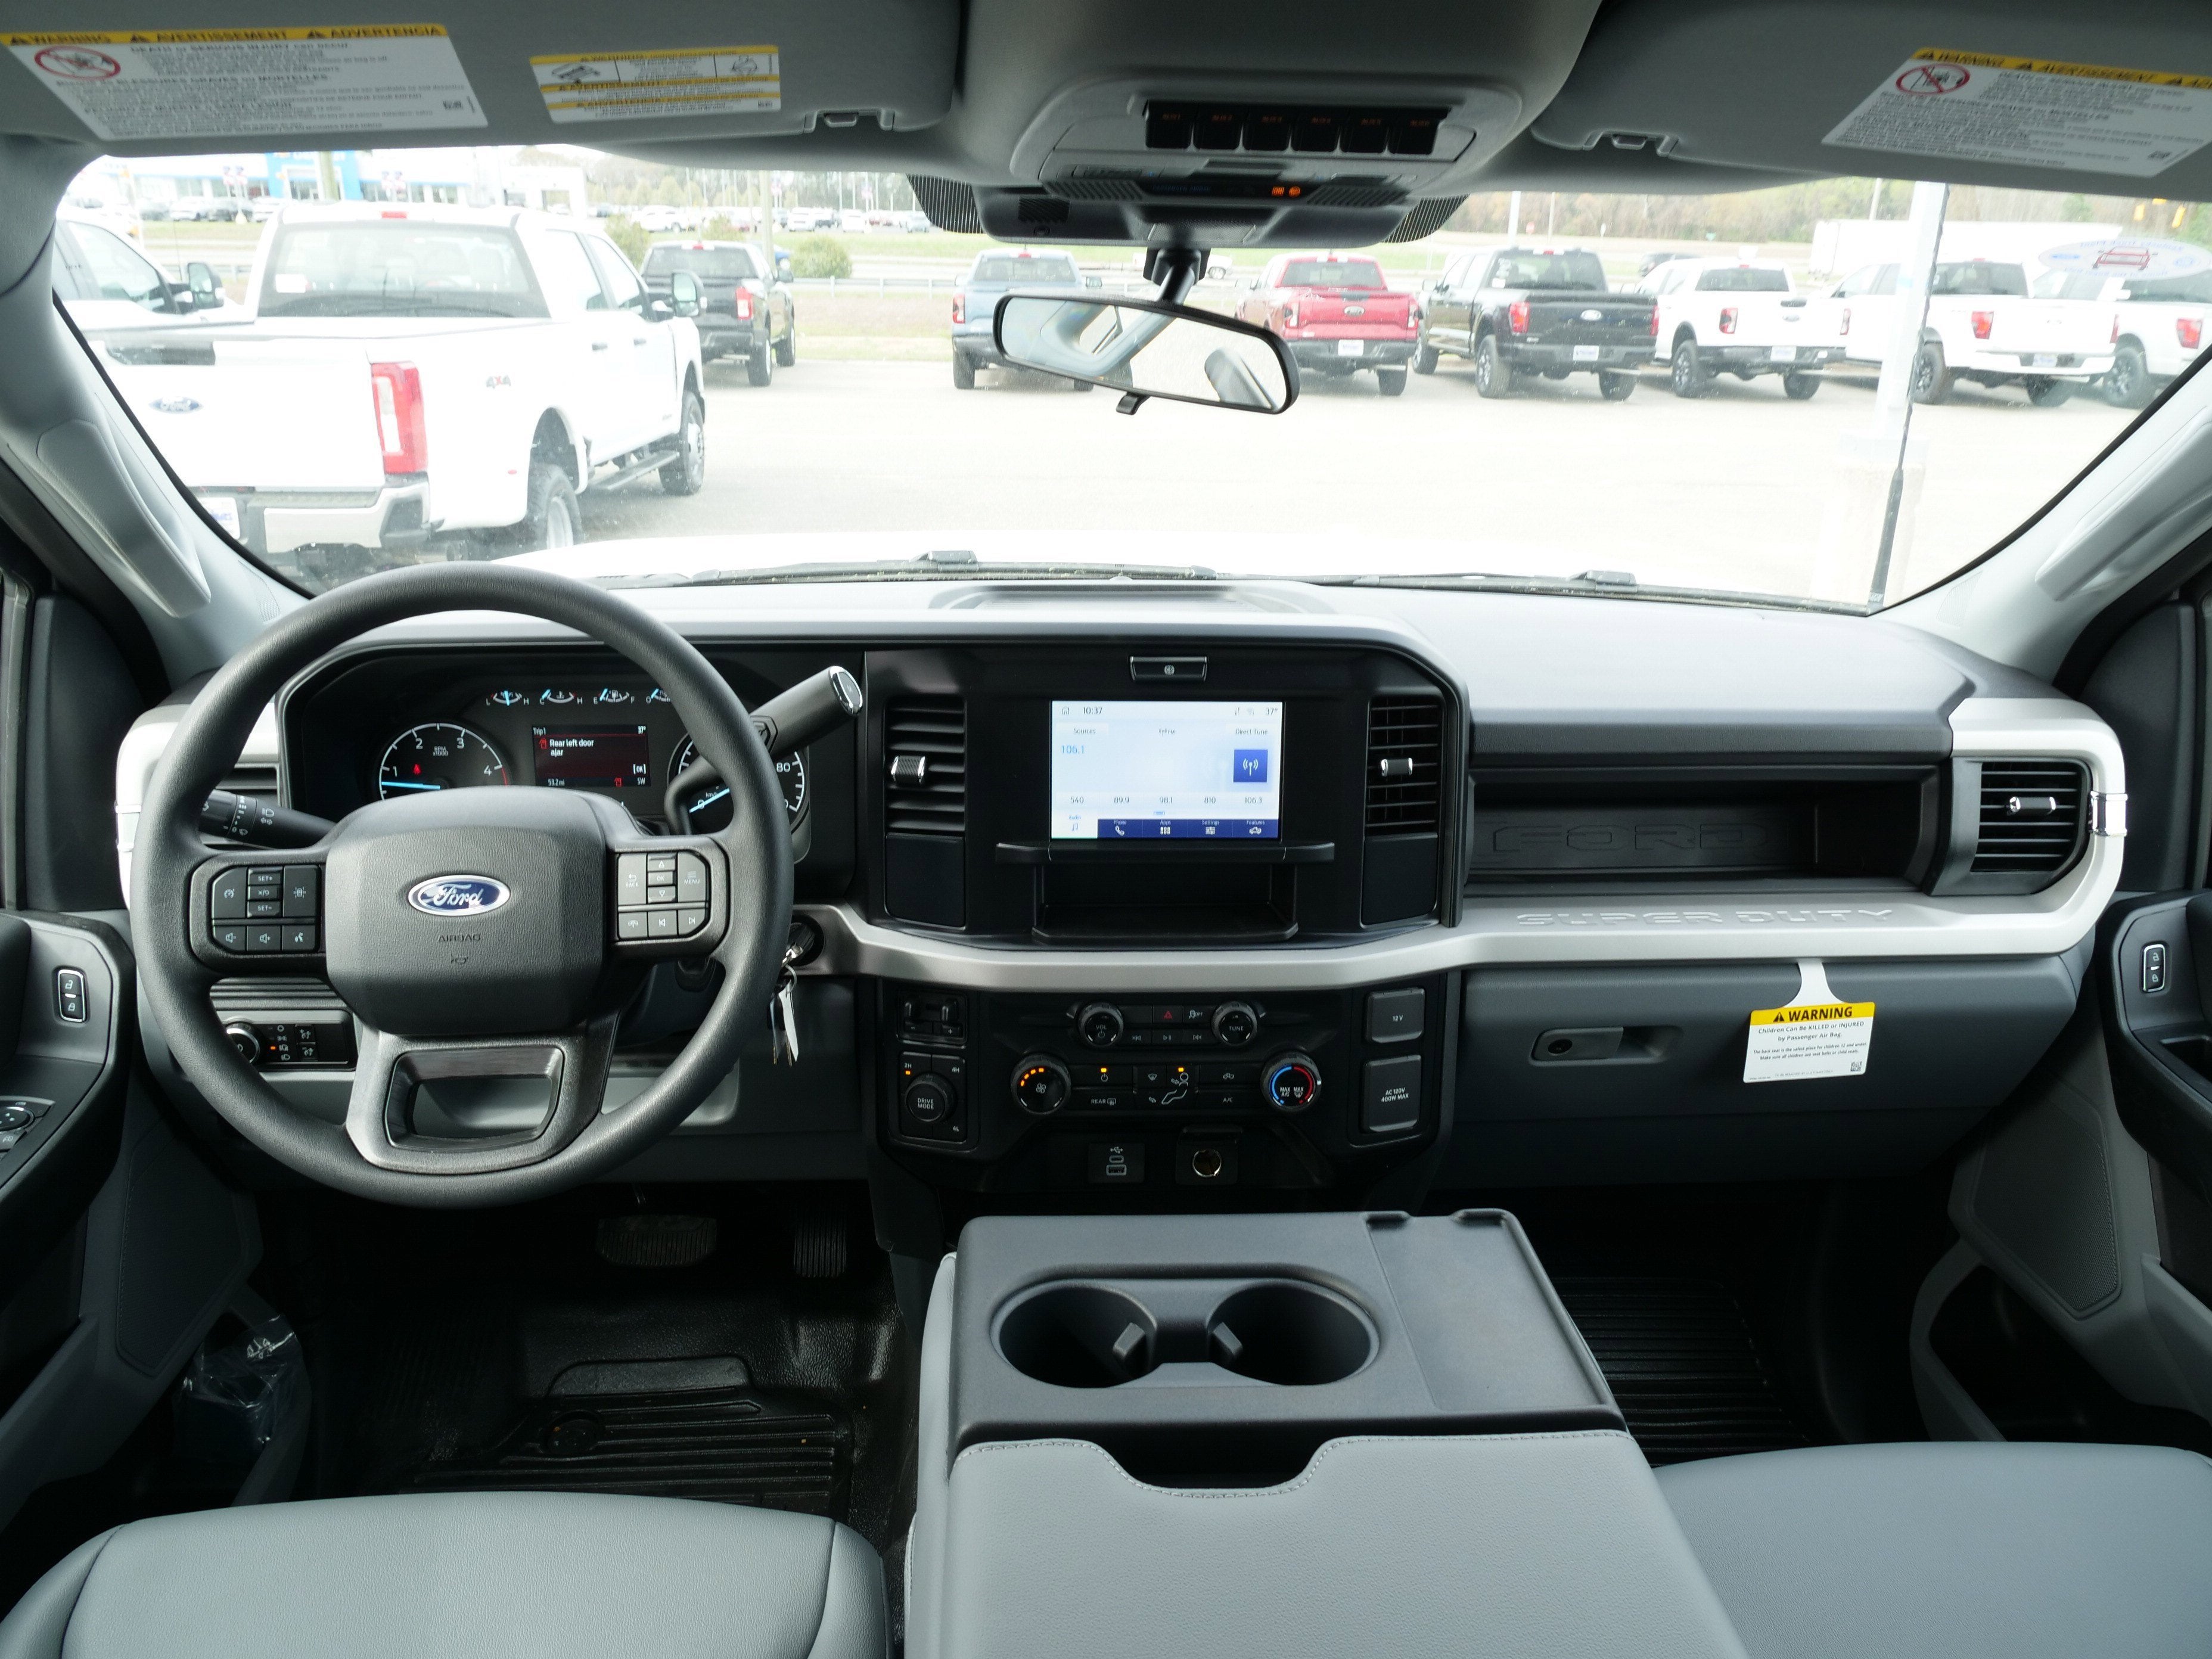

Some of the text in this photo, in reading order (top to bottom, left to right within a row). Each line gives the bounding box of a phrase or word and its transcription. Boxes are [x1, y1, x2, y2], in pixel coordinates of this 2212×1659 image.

[1083, 706, 1103, 714] 10:37
[415, 738, 423, 750] 2
[456, 737, 465, 749] 3
[549, 738, 594, 748] Rear left door
[551, 748, 564, 757] ajar
[1062, 745, 1085, 754] 106.1
[393, 766, 397, 777] 1
[484, 765, 492, 776] 4
[776, 762, 791, 773] 80
[637, 777, 646, 785] SW
[433, 883, 484, 906] Ford
[1517, 909, 1893, 926] SUPER DUTY
[438, 934, 481, 943] AIRBAG
[1788, 1006, 1853, 1023] WARNING
[1787, 1032, 1818, 1041] Passenger
[1381, 1092, 1409, 1103] 400W MAX
